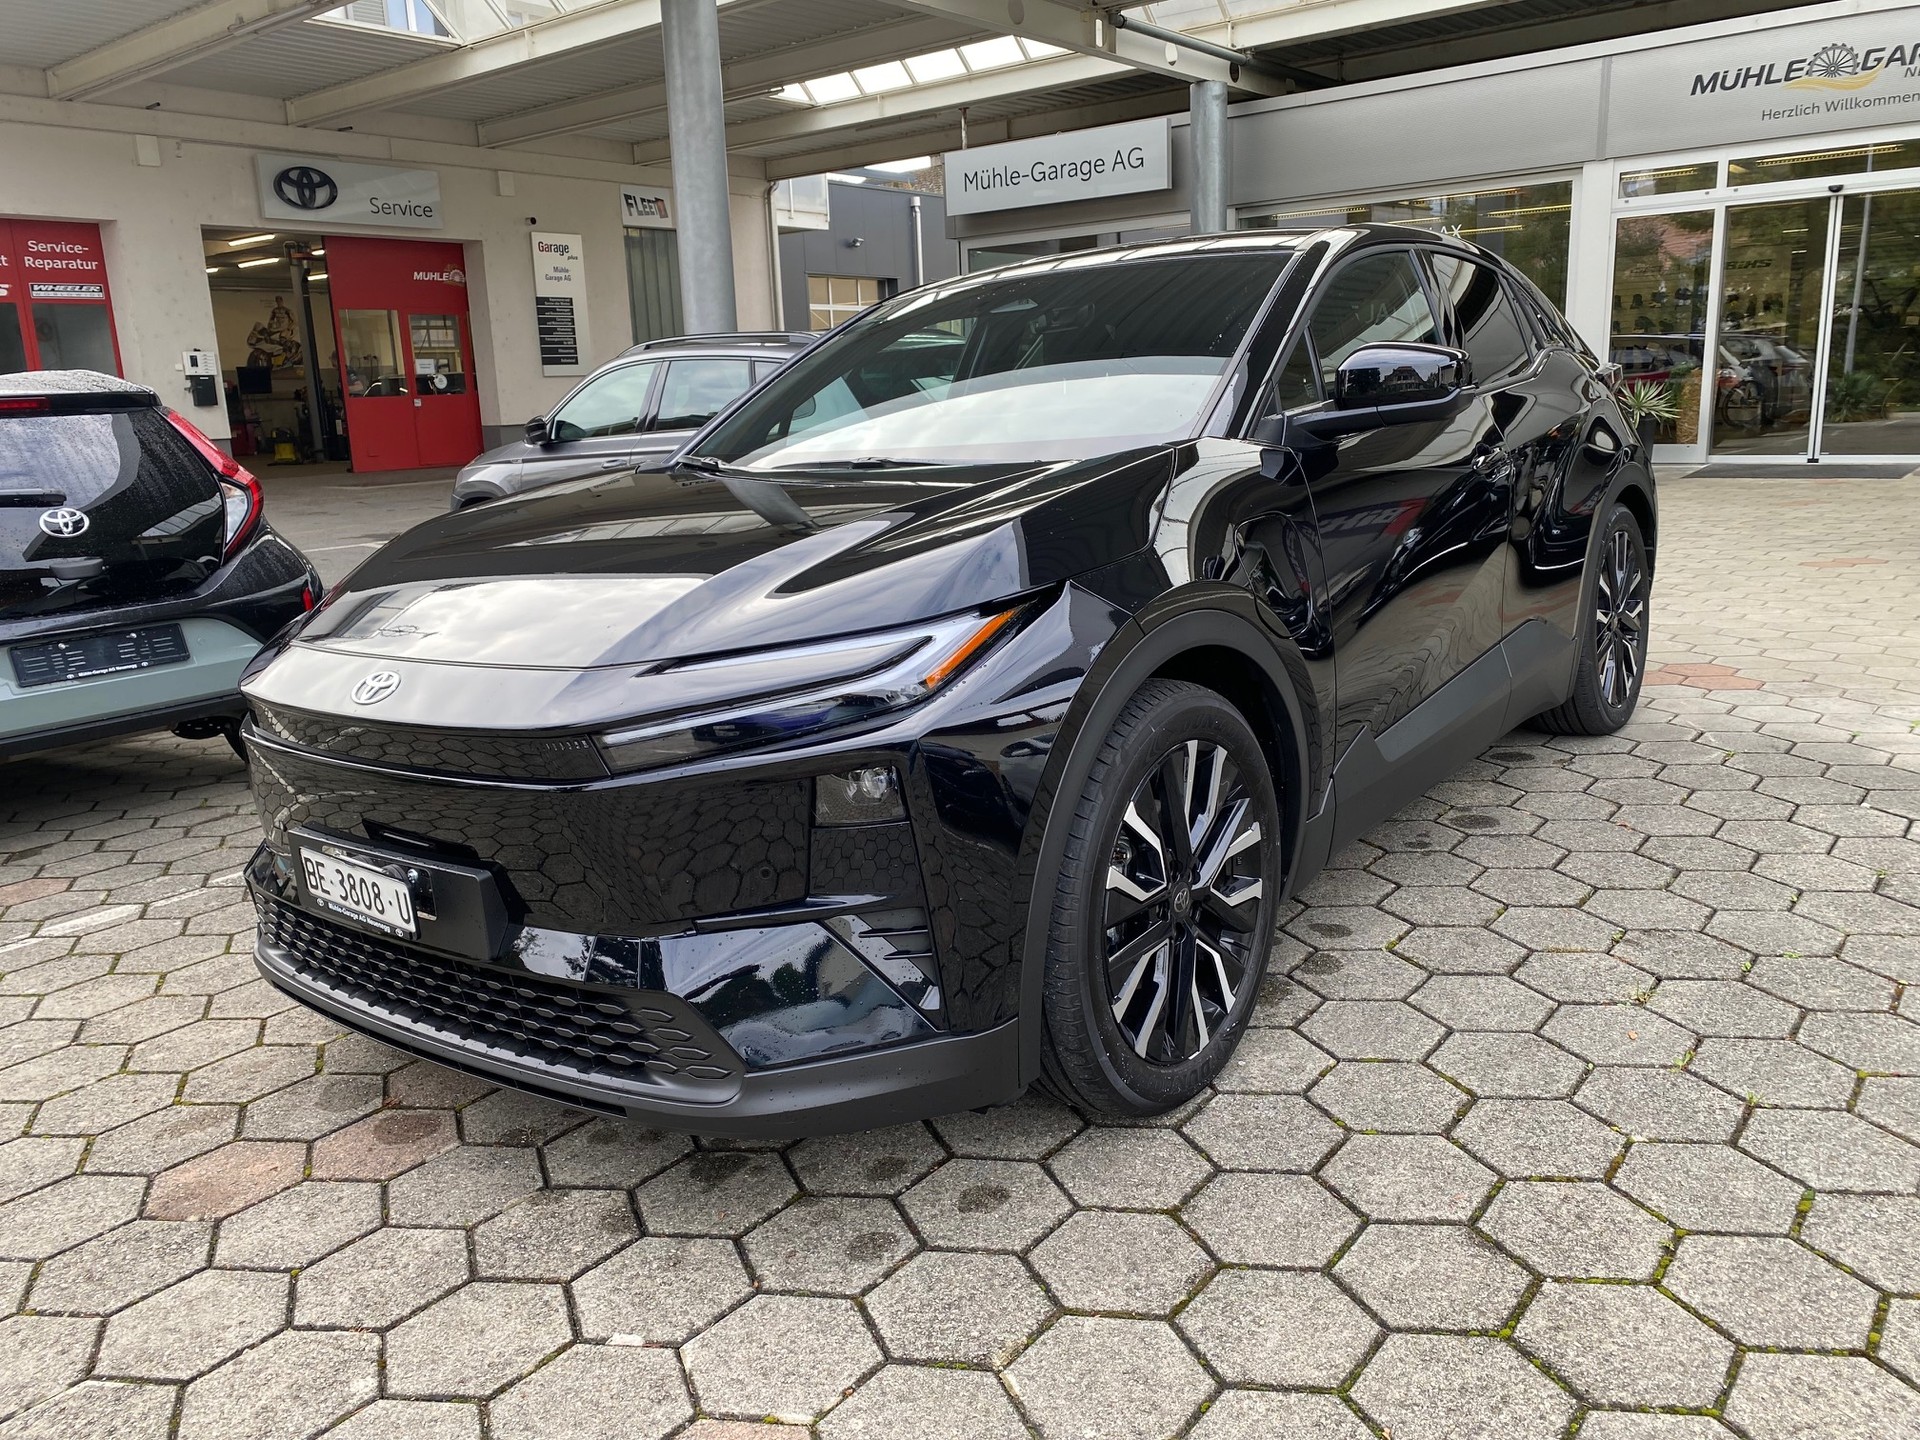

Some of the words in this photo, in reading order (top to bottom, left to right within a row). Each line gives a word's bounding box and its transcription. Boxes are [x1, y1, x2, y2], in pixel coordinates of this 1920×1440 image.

[1690, 58, 1807, 96] MÜHLE
[1761, 102, 1820, 121] Herzlich
[1825, 91, 1920, 113] Willkommen
[964, 157, 1105, 193] Mühle-Garage
[1112, 147, 1144, 172] AG
[369, 197, 433, 218] Service
[27, 240, 89, 254] Service-
[538, 241, 569, 256] Garage
[24, 256, 98, 270] Reparatur
[545, 273, 563, 282] Garage
[32, 284, 101, 292] WHEELER
